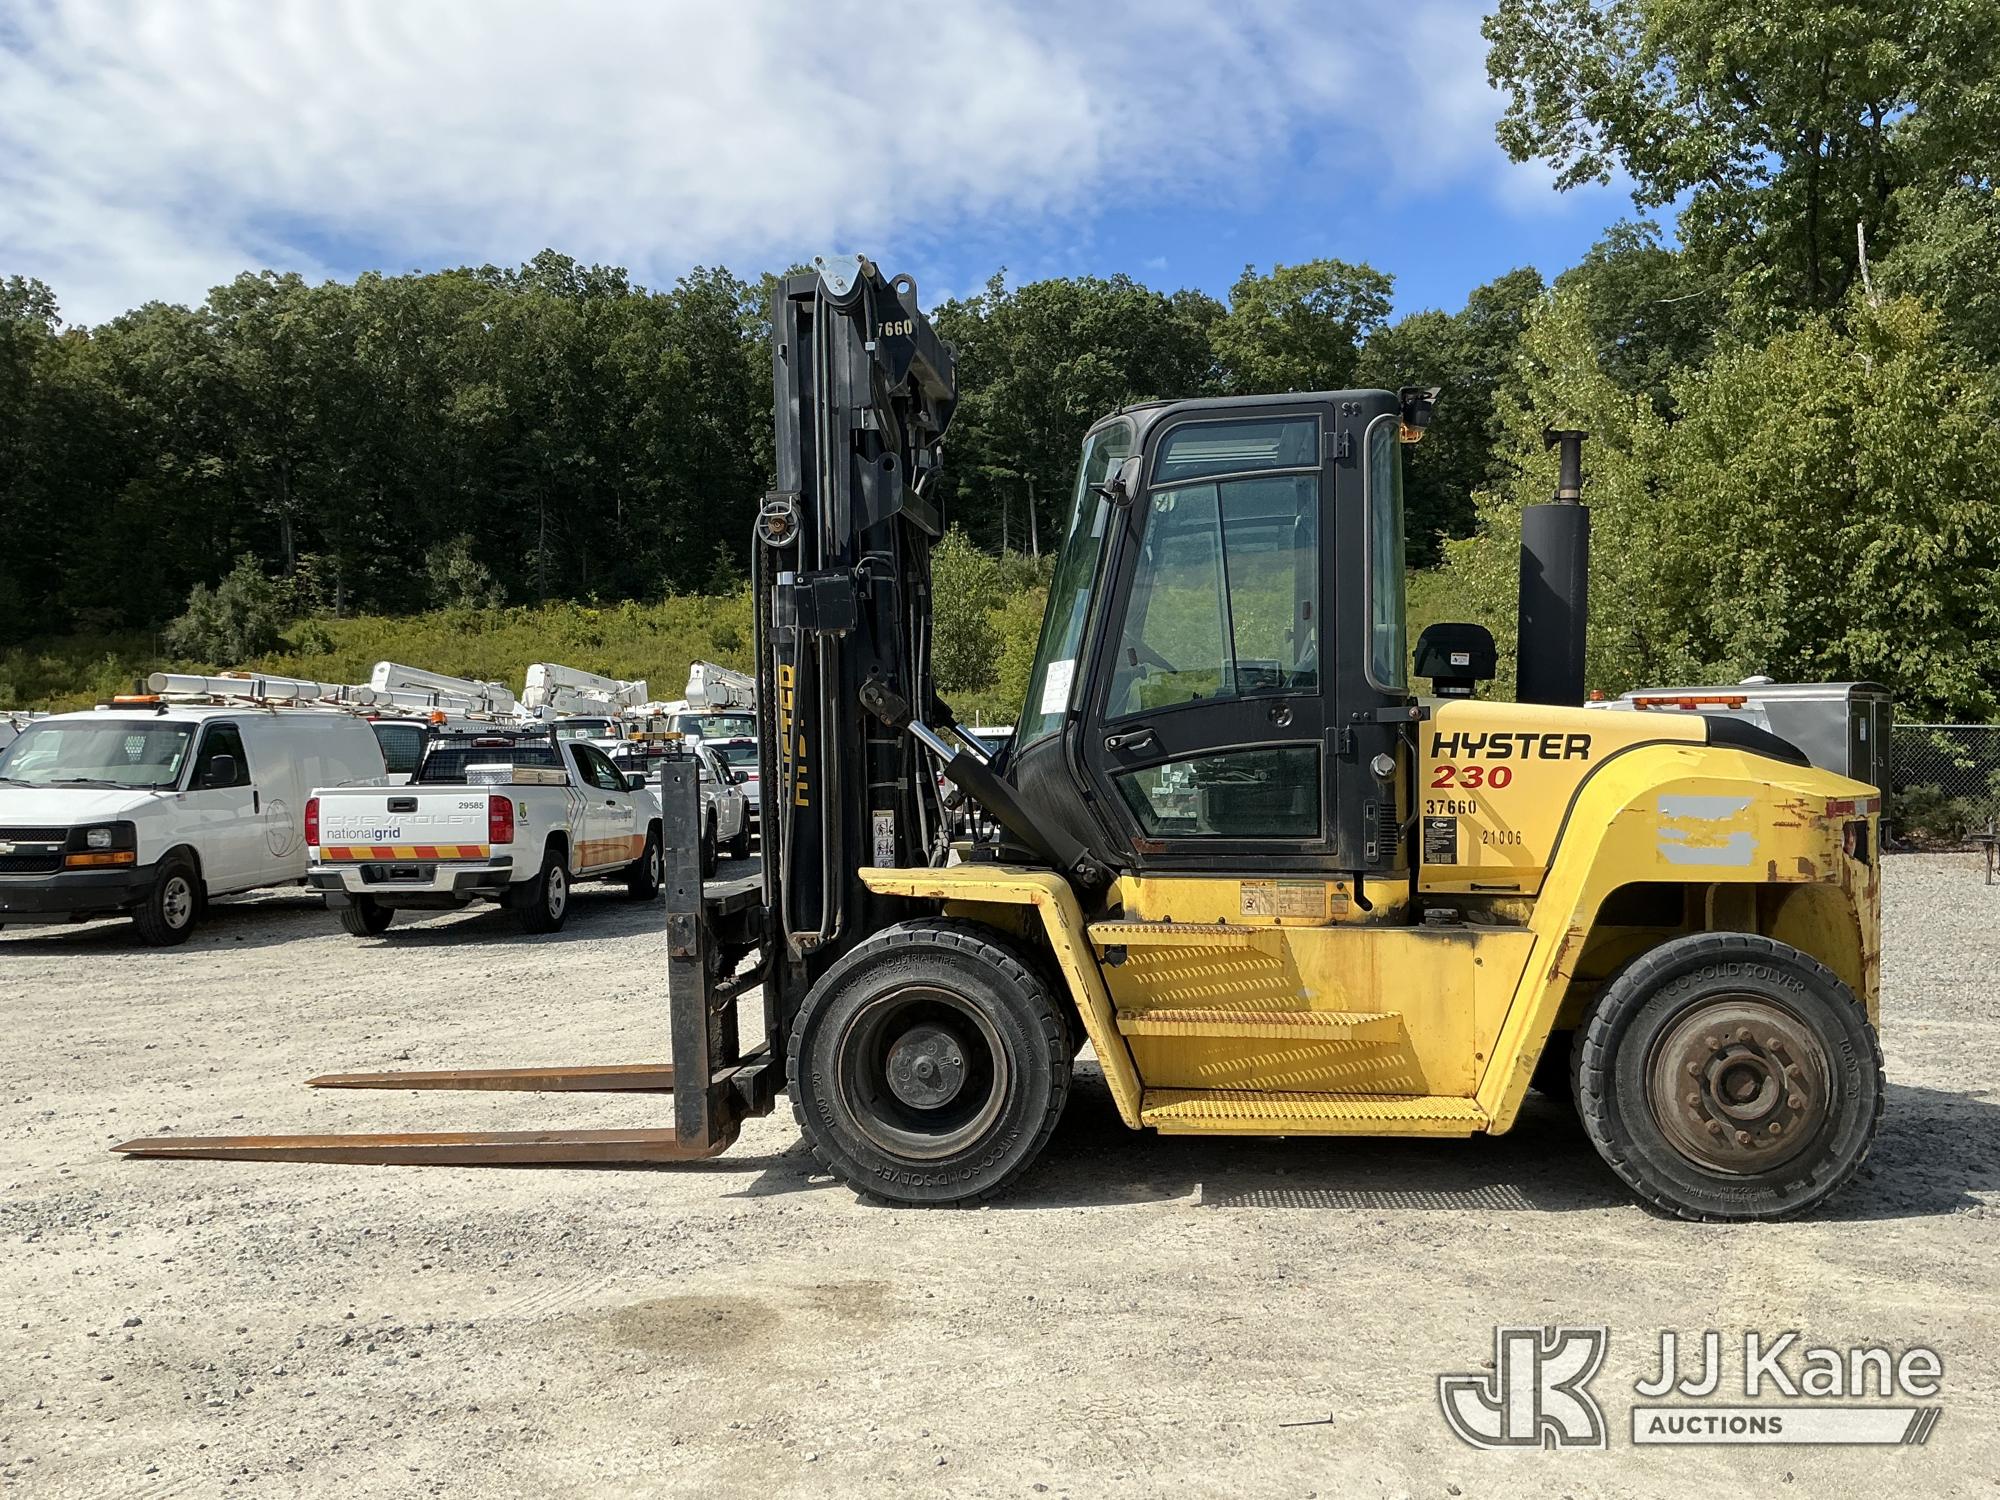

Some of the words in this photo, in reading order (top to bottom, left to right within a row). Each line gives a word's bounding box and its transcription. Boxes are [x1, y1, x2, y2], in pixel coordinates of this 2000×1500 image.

[1430, 732, 1592, 760] HYSTER
[1430, 765, 1513, 789] 230
[458, 801, 485, 810] 29585
[1425, 799, 1477, 815] 37660
[327, 826, 401, 842] nationalgrid
[1482, 830, 1522, 845] 21006
[1695, 962, 1740, 982] SOLID
[1746, 963, 1806, 995] SOLVER
